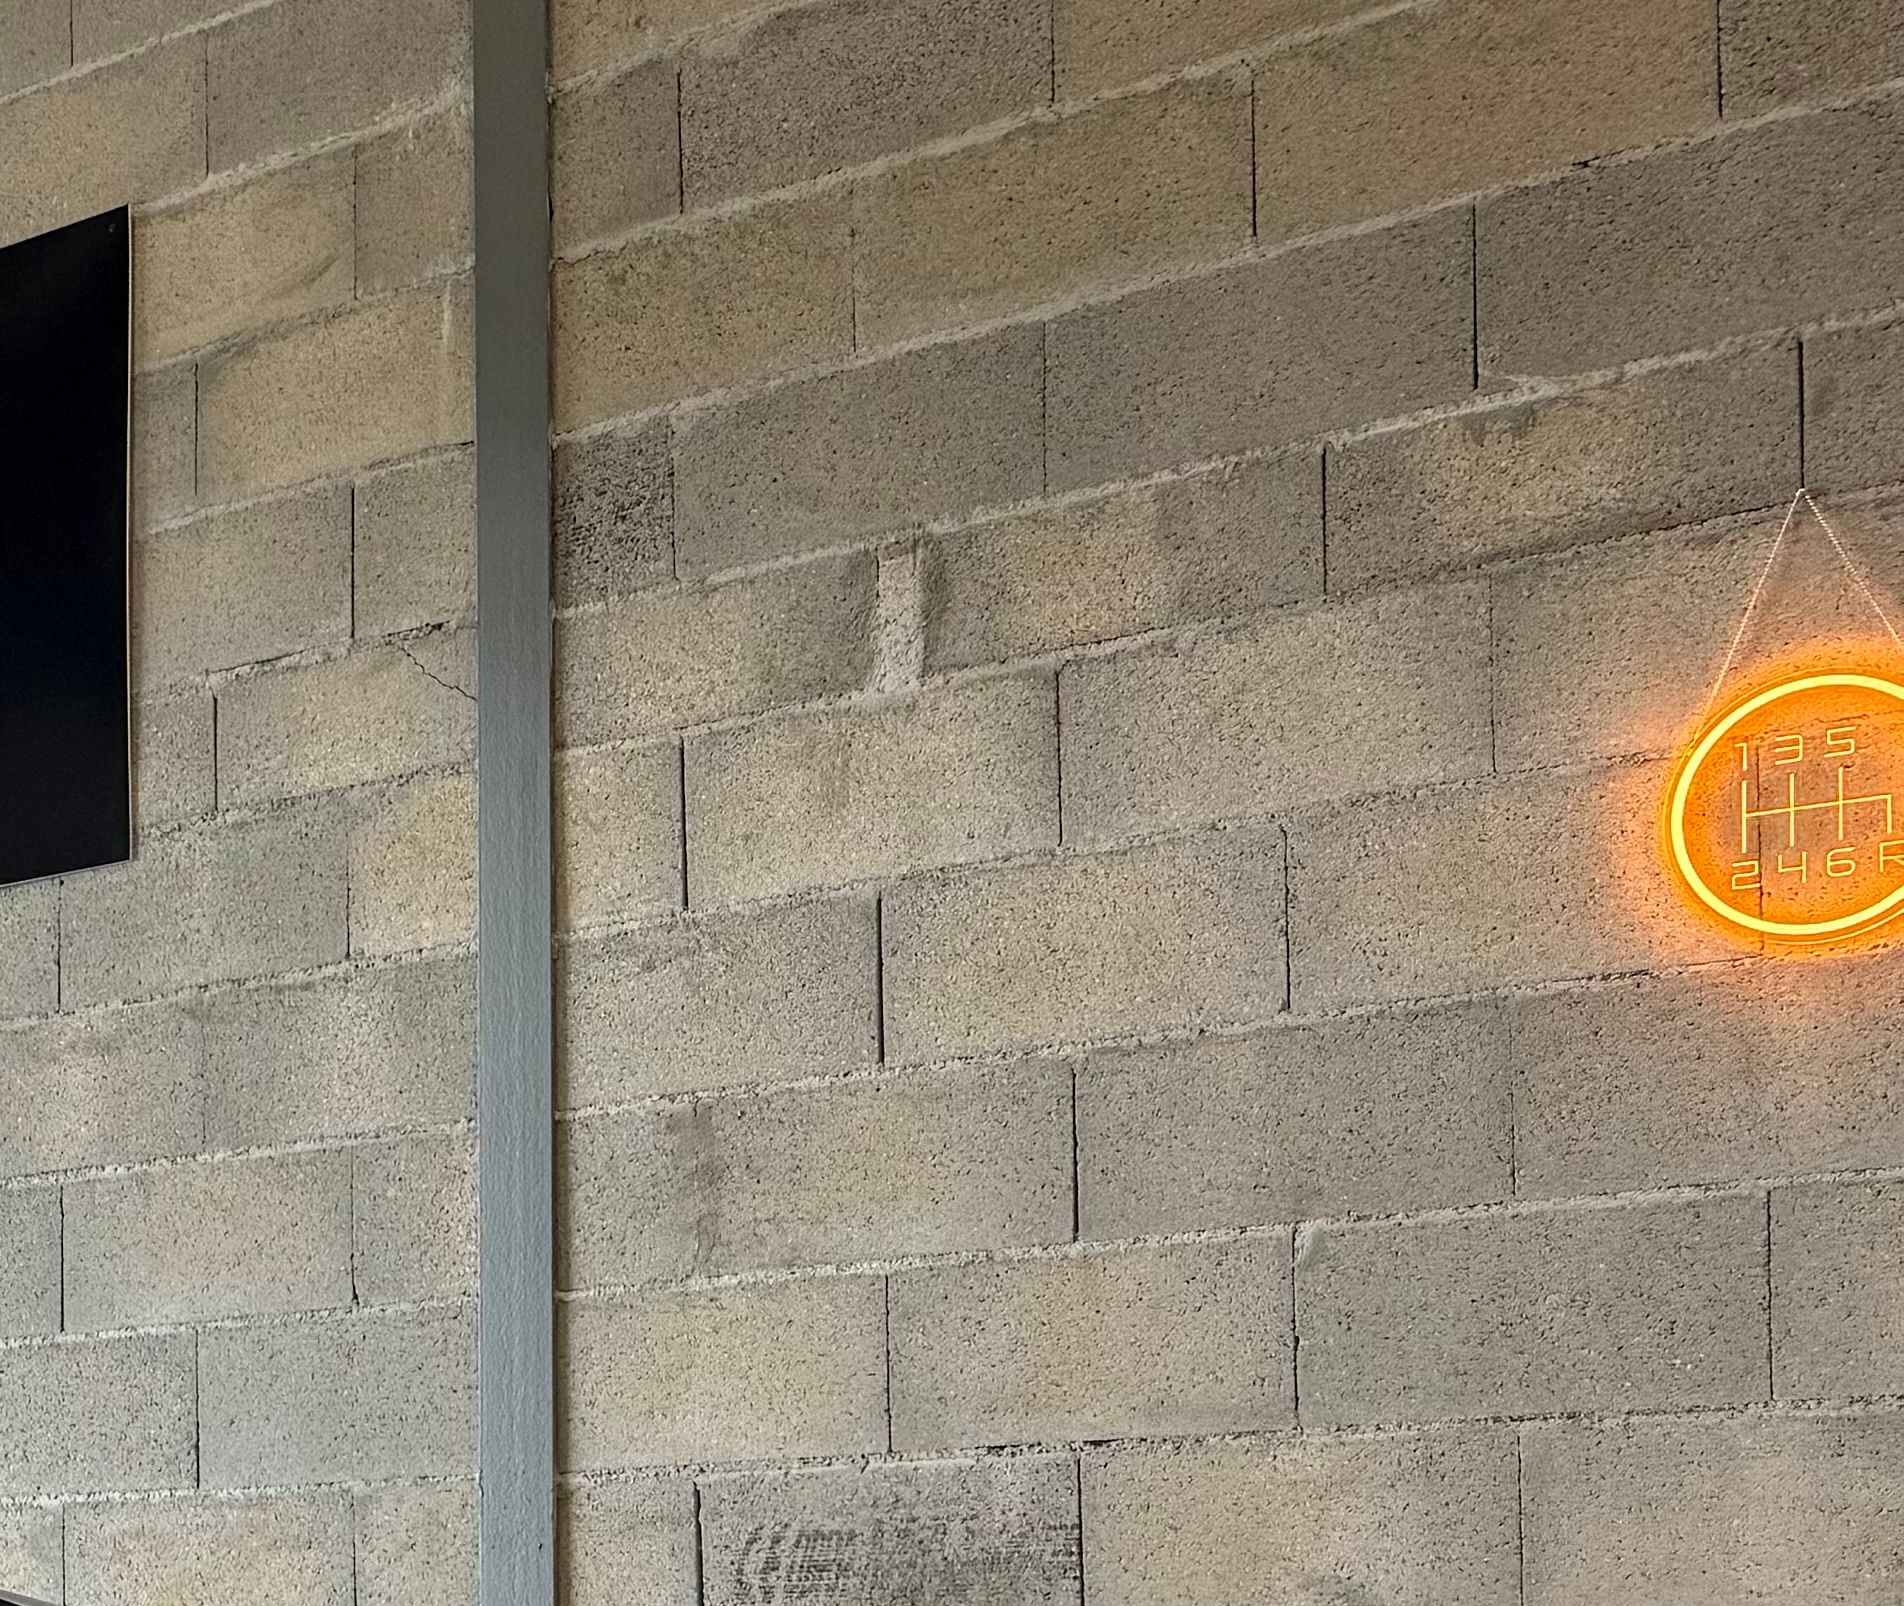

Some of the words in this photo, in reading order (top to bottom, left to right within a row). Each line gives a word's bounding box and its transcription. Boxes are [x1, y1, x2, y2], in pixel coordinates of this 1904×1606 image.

[1734, 742, 1748, 772] 1
[1773, 734, 1803, 766] 3
[1823, 726, 1856, 759] 5
[1731, 860, 1761, 890] 2
[1777, 851, 1807, 884] 4
[1826, 846, 1856, 878] 6
